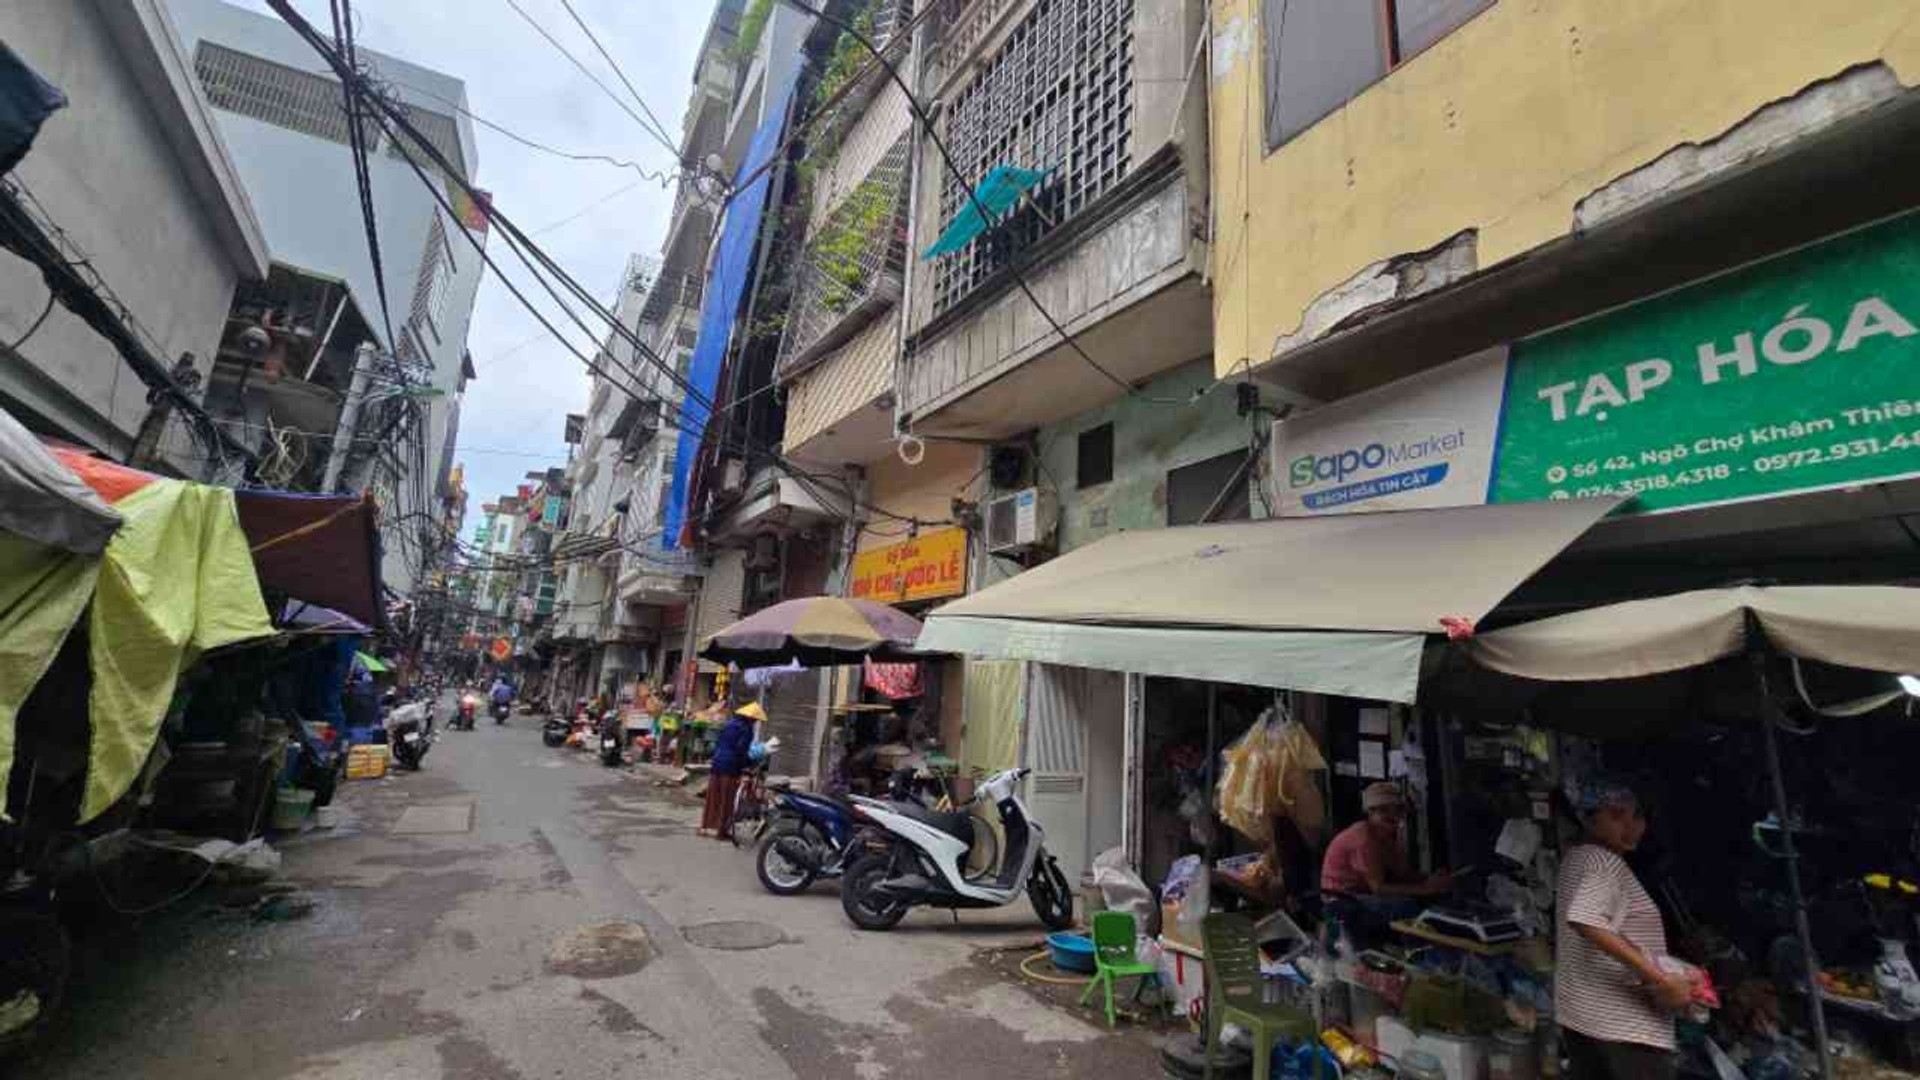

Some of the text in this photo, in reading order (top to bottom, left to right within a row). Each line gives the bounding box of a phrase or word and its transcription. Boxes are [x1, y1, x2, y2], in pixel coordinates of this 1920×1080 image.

[1537, 297, 1920, 421] TẠP HÓA
[1572, 459, 1598, 478] Số
[1641, 444, 1689, 465] Ngõ
[1694, 433, 1744, 452] Chợ
[1750, 418, 1835, 444] Khâm
